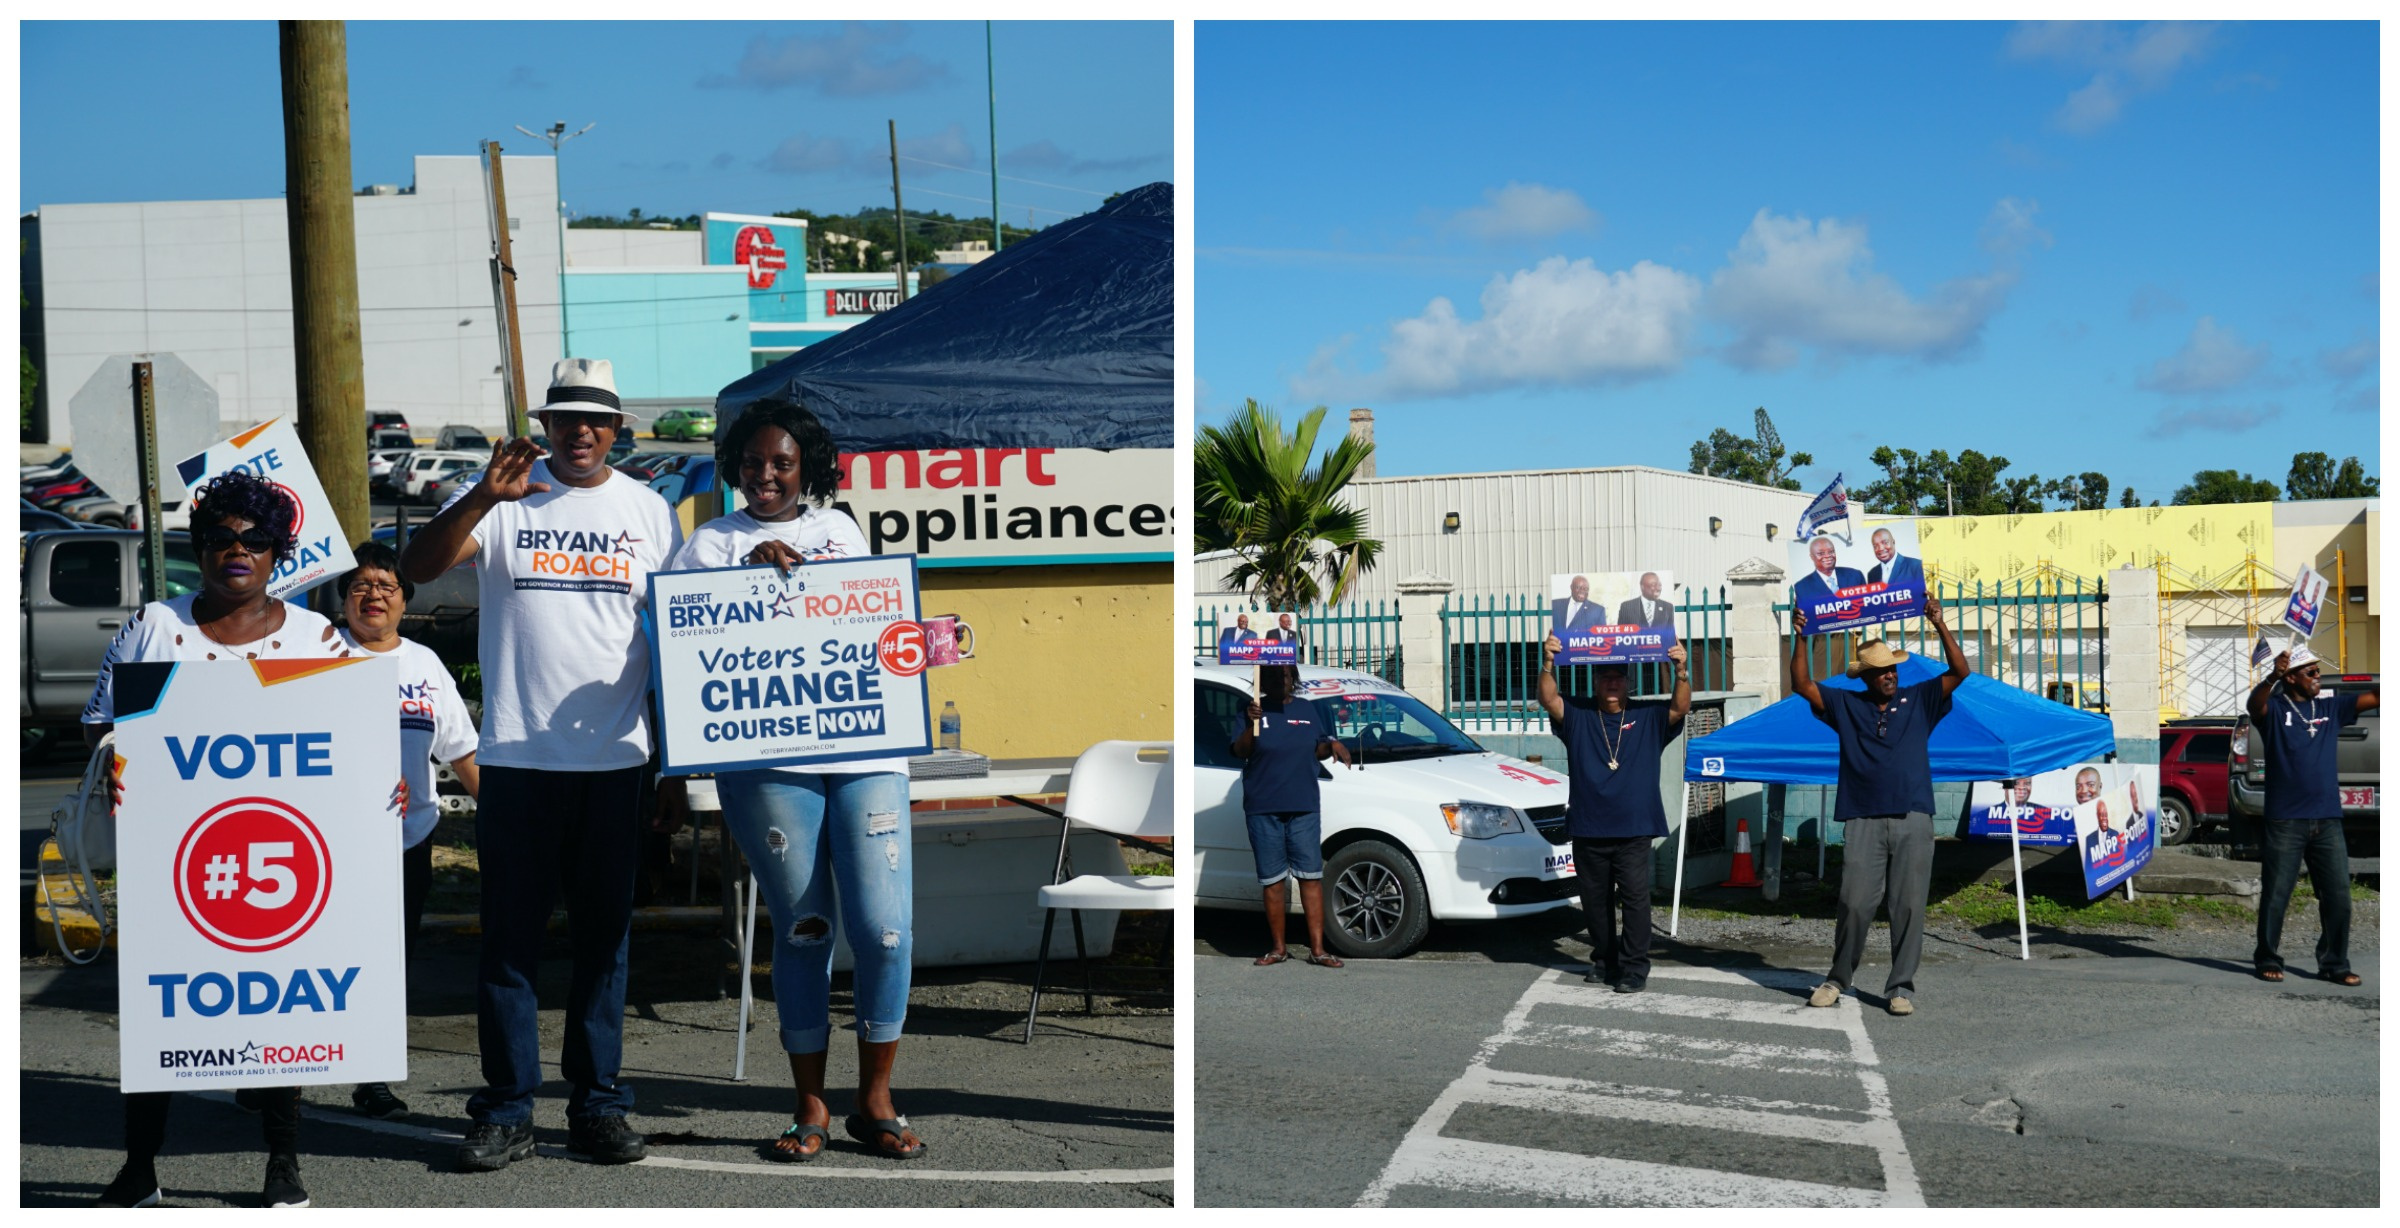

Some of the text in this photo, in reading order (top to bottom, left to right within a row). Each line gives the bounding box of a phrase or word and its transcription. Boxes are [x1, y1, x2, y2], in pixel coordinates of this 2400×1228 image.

[836, 292, 863, 312] DELI
[831, 493, 1175, 555] ppliance
[515, 528, 610, 554] BRYAN
[298, 567, 326, 584] ROACH
[531, 551, 631, 580] ROACH
[527, 581, 562, 589] GOVERNOR
[583, 583, 616, 591] GOVERNOR
[750, 581, 806, 596] 2018
[839, 577, 901, 592] TREGENZA
[1841, 583, 1882, 597] VOTE #1
[668, 589, 904, 629] BRYAN ROACH
[669, 592, 713, 606] ALBERT
[1814, 599, 1852, 615] MAPP
[1862, 588, 1913, 607] POTTER
[831, 612, 905, 626] LT. GOVERNOR
[670, 626, 726, 638] GOVERNOR
[1595, 625, 1634, 634] VOTE #1
[881, 630, 926, 669] #5
[926, 628, 954, 660] Juicy
[1228, 646, 1254, 655] MAPP
[1260, 646, 1295, 654] POTTER
[1569, 634, 1662, 648] MAPP POTTER
[697, 638, 878, 675] Voters Say
[700, 667, 884, 714] CHANGE
[702, 707, 884, 743] COURSE NOW
[163, 731, 334, 781] VOTE
[759, 742, 837, 756] VOTEBRYANROACH.COM
[1987, 805, 2036, 820] MAPP
[2089, 835, 2119, 864] MAPP
[1544, 853, 1573, 868] MAP
[203, 840, 299, 911] #5
[148, 966, 362, 1019] TODAY
[159, 1043, 344, 1069] BRYAN ROACH
[175, 1065, 330, 1079] FOR GOVERNOR AND LT. GOVERNOR
